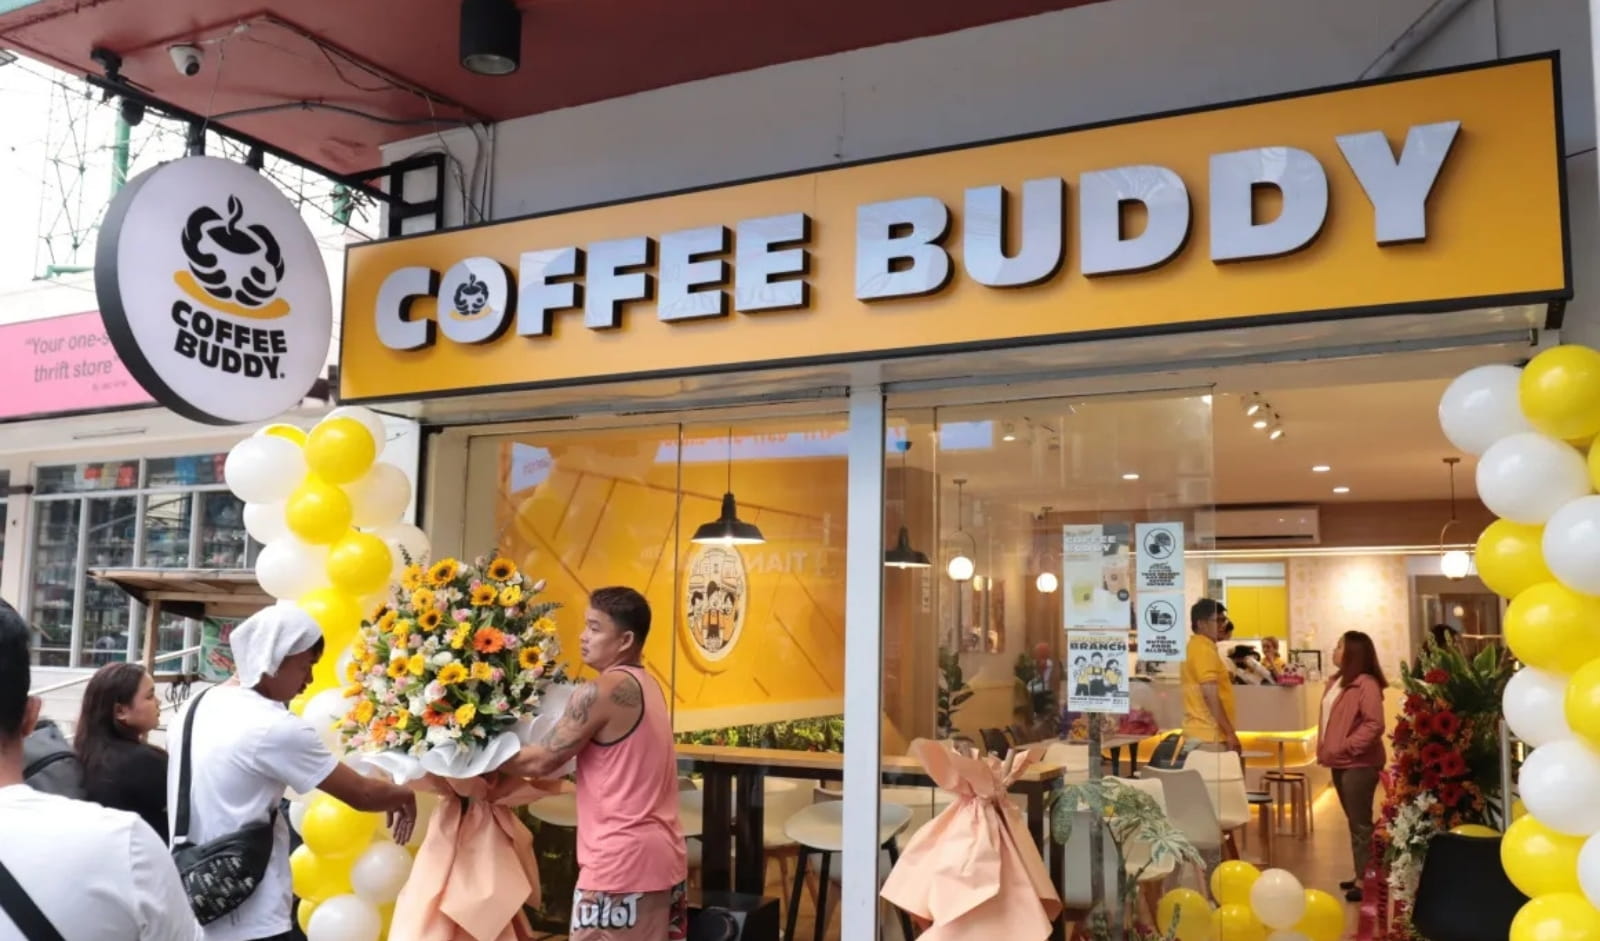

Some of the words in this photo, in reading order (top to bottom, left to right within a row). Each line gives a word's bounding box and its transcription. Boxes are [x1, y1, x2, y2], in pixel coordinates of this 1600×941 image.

[375, 212, 812, 352] COFFEE
[855, 120, 1462, 303] BUDDY
[171, 300, 287, 353] COFFEE
[34, 361, 69, 382] thrift
[1070, 642, 1126, 651] BRANCH
